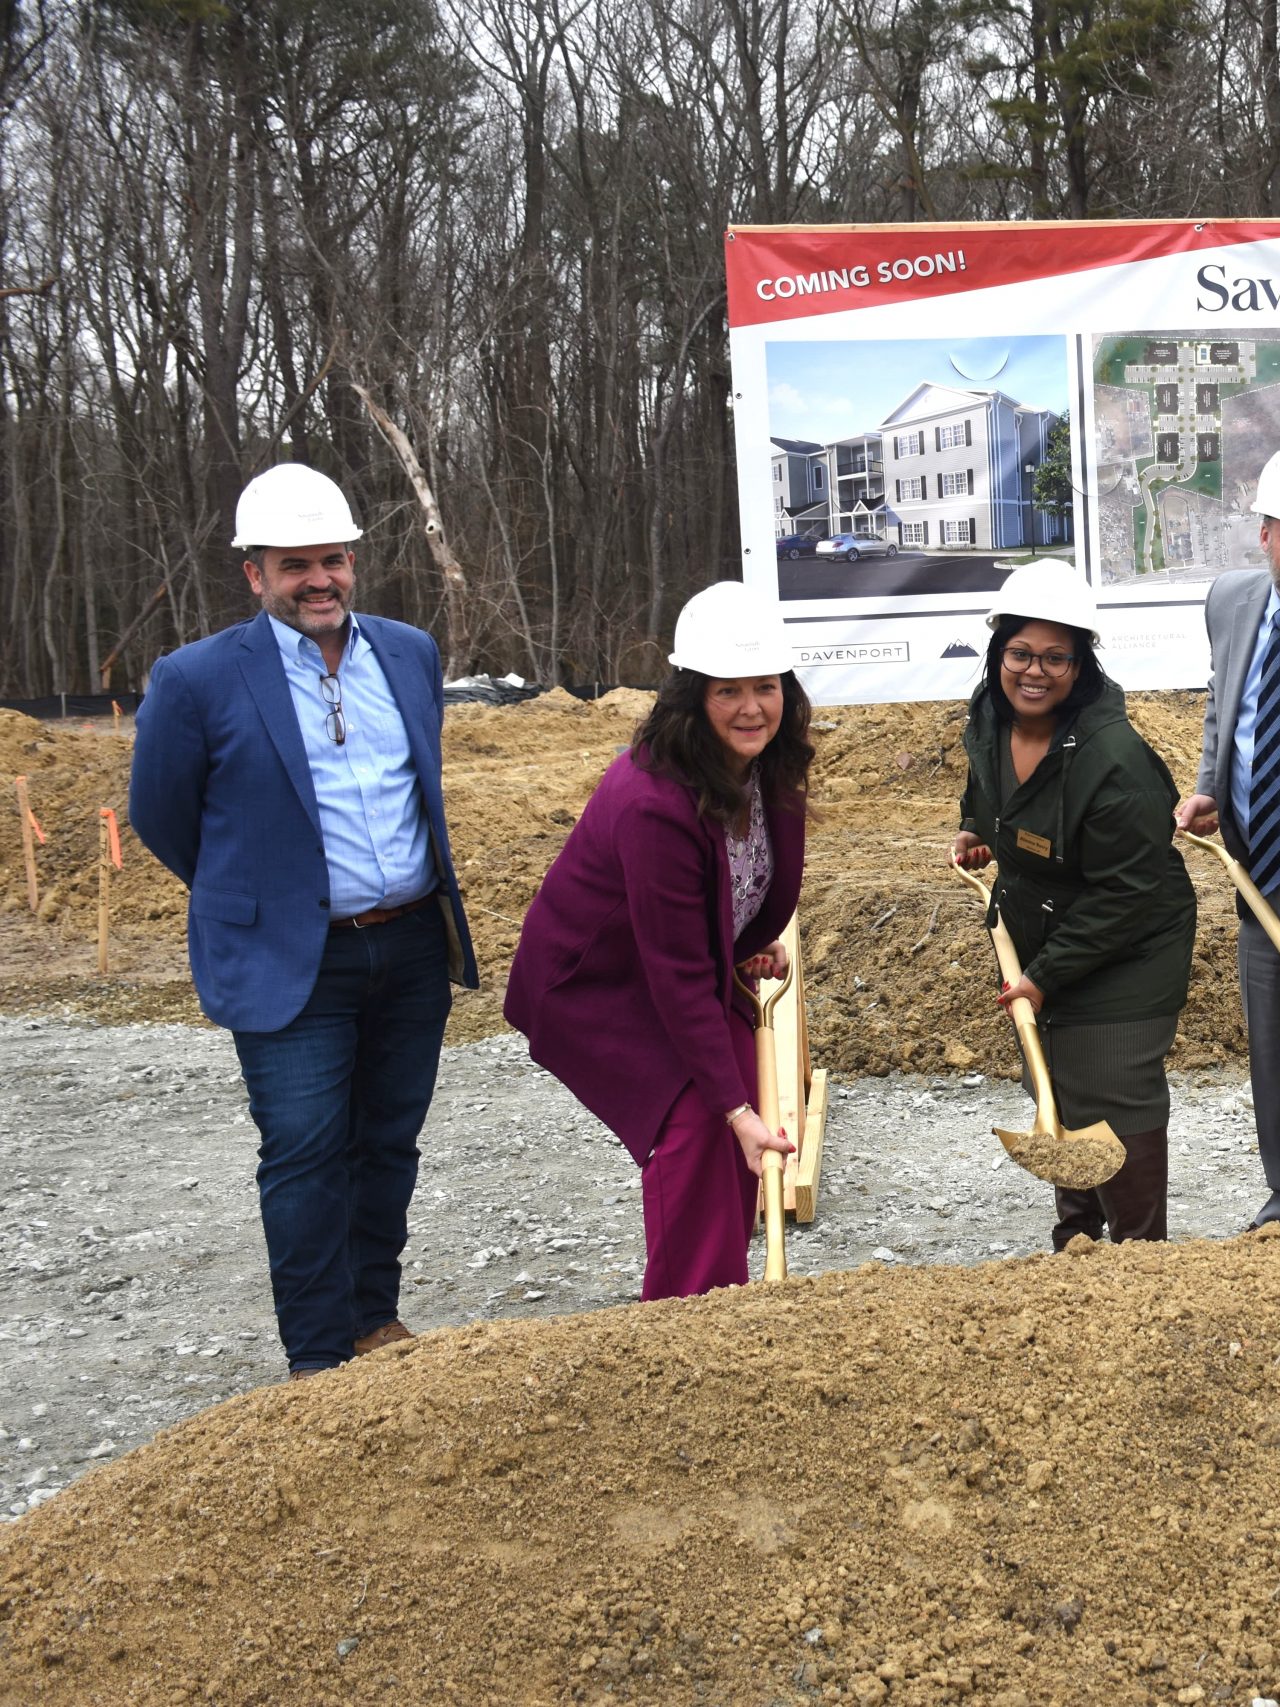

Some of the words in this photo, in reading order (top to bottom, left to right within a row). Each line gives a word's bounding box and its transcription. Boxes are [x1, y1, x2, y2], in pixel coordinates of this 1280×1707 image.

[756, 264, 871, 301] COMING
[877, 250, 967, 284] SOON!
[1111, 633, 1186, 642] ARCHITECTURAL
[1111, 641, 1157, 650] ALLIANCE
[800, 647, 903, 661] DAVENPORT
